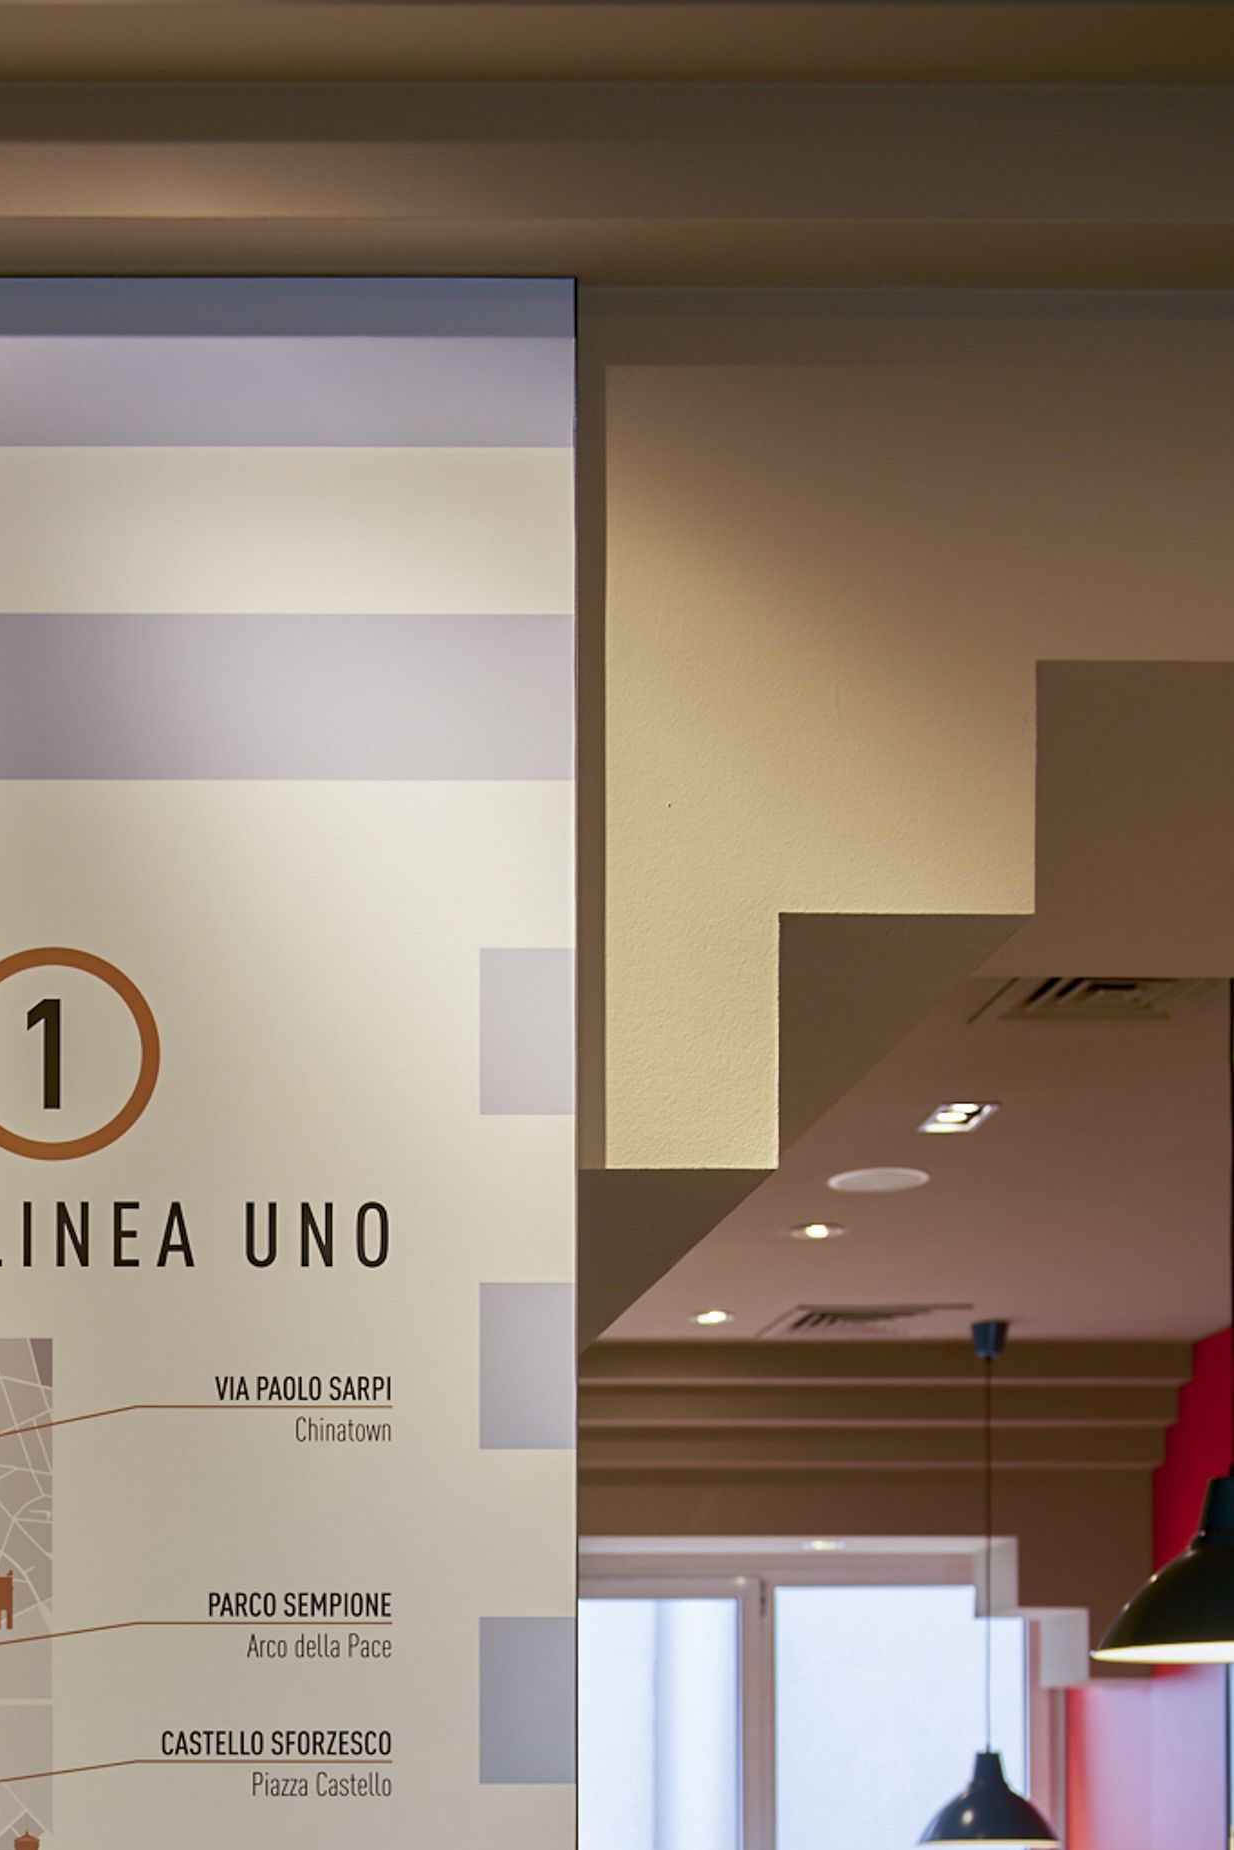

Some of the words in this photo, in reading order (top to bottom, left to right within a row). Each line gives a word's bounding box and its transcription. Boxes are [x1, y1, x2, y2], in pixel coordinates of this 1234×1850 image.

[27, 999, 61, 1109] 1
[246, 1201, 388, 1268] UNO
[215, 1376, 249, 1400] VIA
[257, 1376, 321, 1401] PAOLO
[329, 1376, 391, 1401] SARPI
[296, 1416, 391, 1442] Chinatown
[209, 1592, 276, 1617] PARCO
[284, 1592, 391, 1617] SEMPIONE
[247, 1634, 287, 1658] Arco
[295, 1633, 340, 1658] della
[349, 1633, 391, 1658] Pace
[162, 1730, 264, 1756] CASTELLO
[271, 1730, 391, 1755] SFORZESCO
[253, 1772, 308, 1796] Piazza
[316, 1772, 391, 1796] Castello
